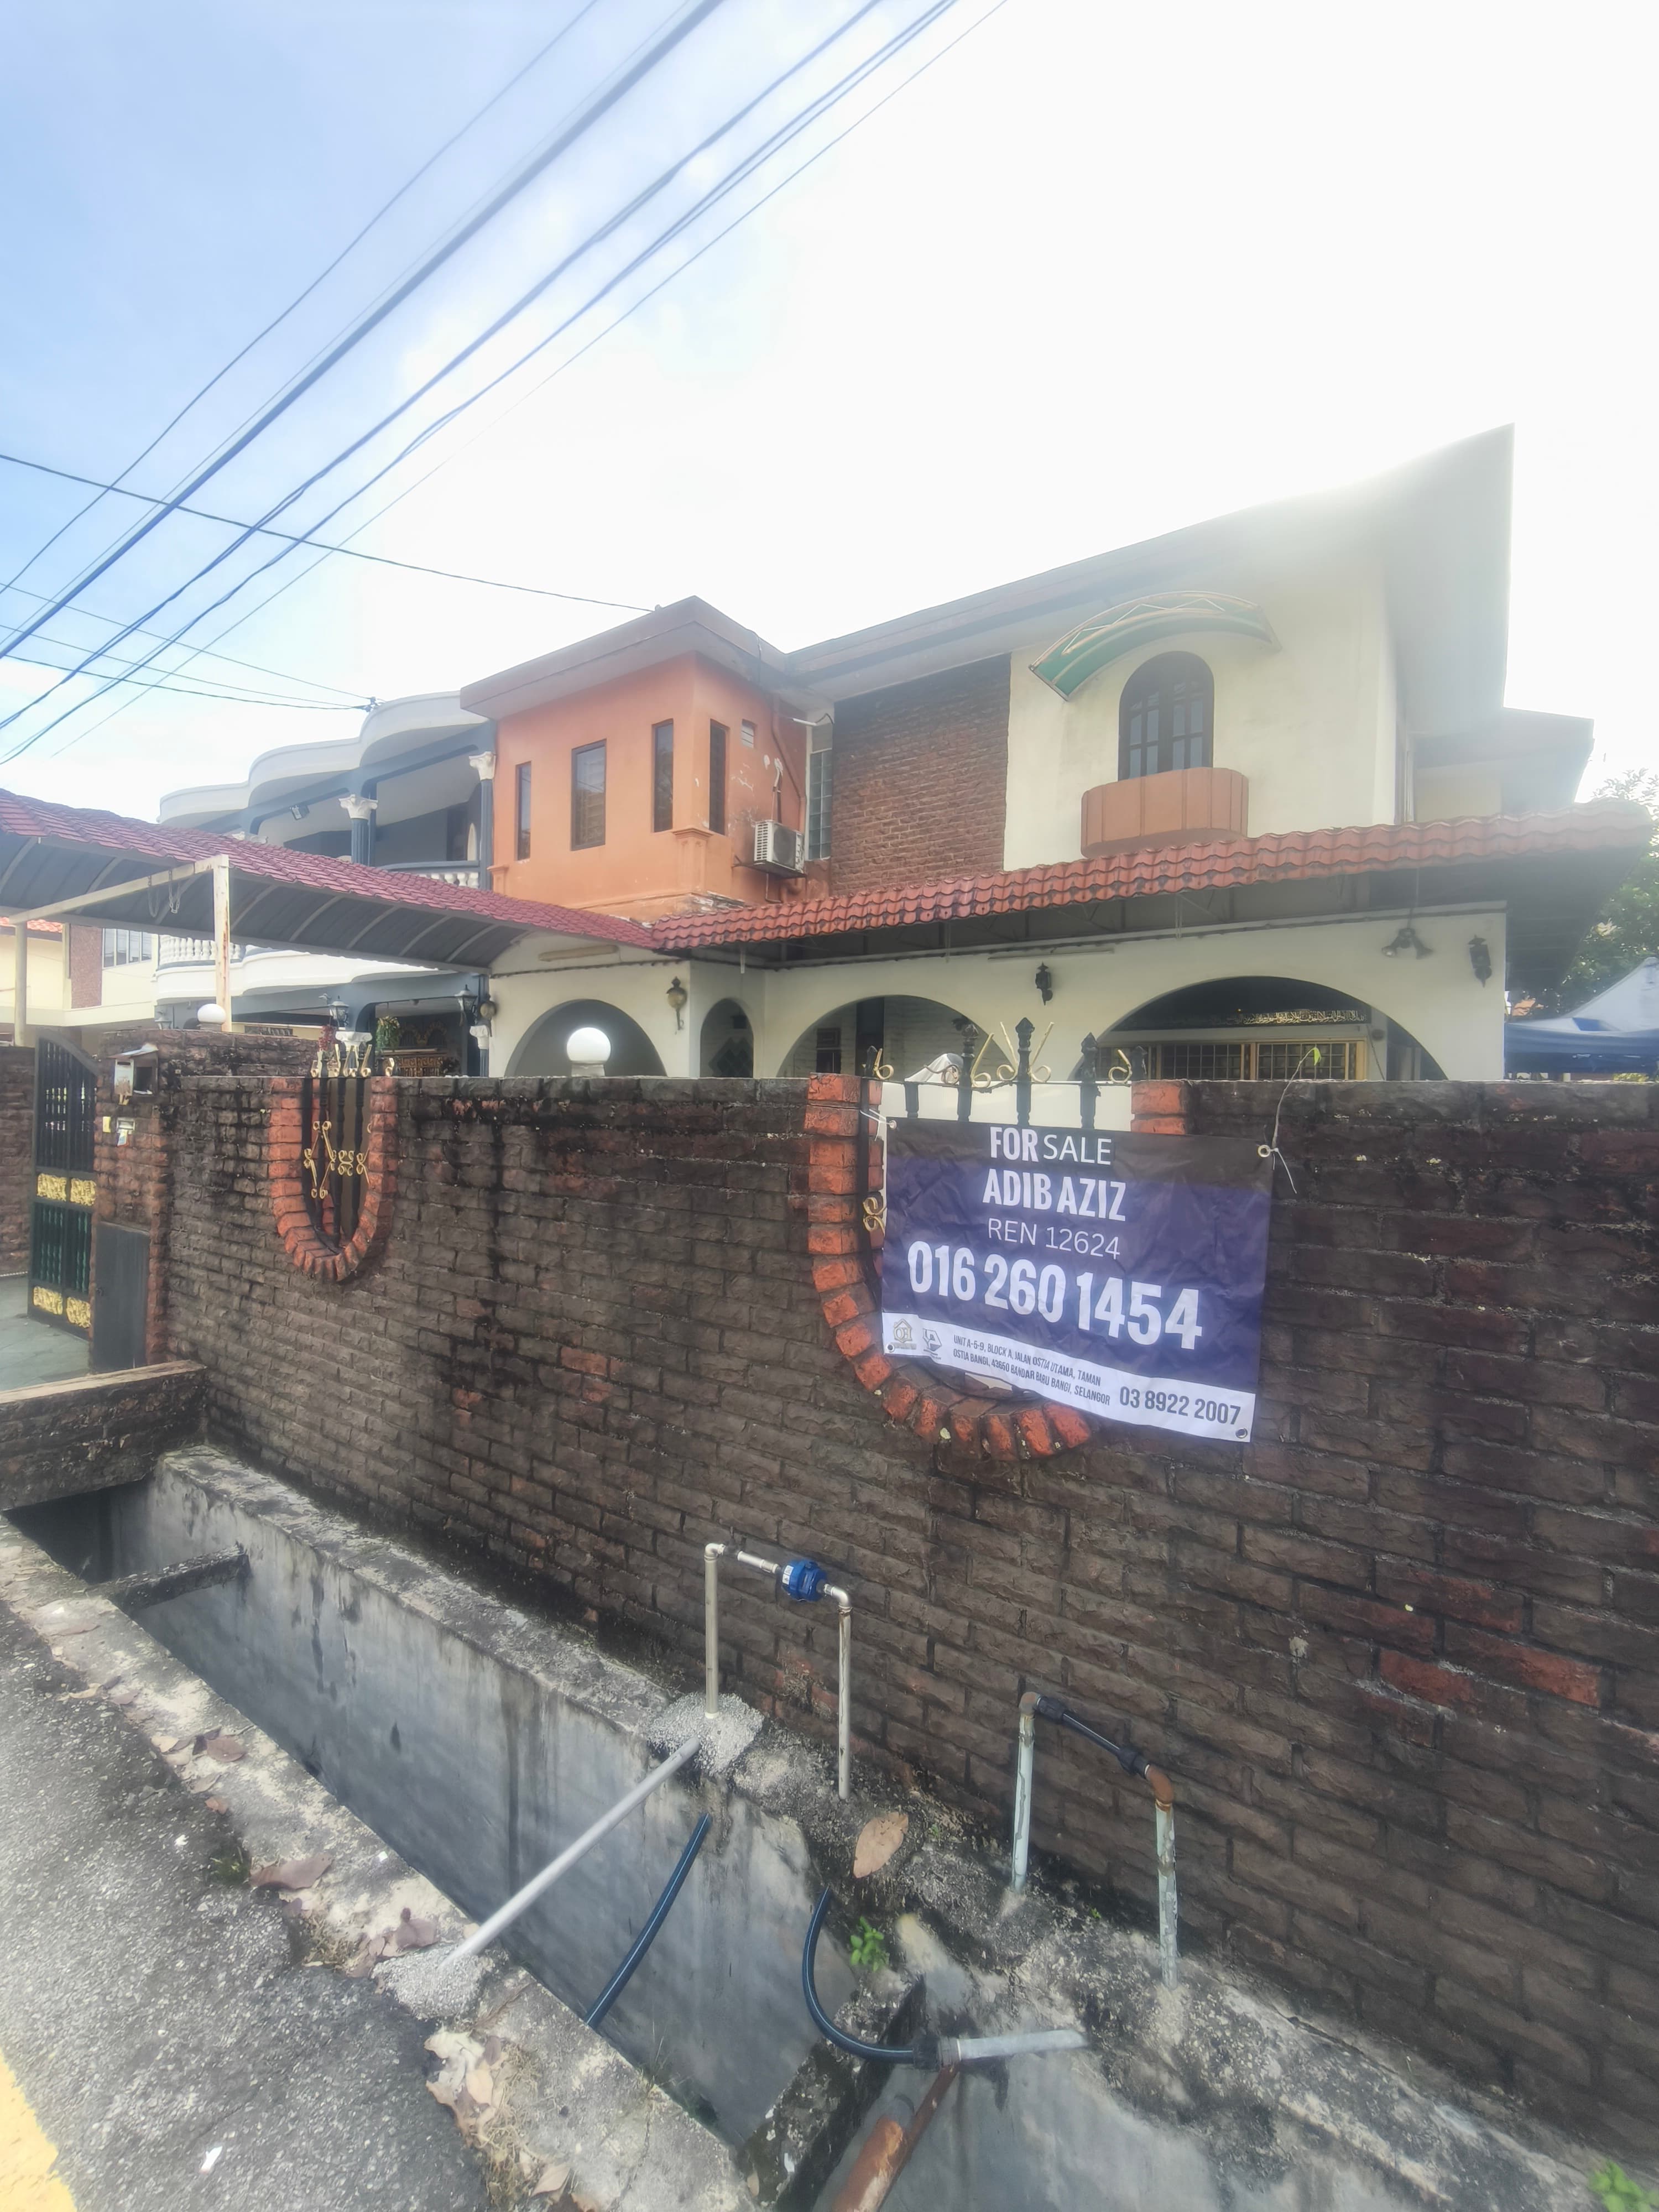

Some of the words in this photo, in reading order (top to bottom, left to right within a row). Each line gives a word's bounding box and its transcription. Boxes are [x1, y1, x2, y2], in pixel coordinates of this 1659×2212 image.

[990, 1126, 1039, 1162] FOR
[1044, 1134, 1112, 1165] SALE
[982, 1168, 1052, 1210] ADIB
[1057, 1176, 1126, 1222] AZIZ
[988, 1218, 1037, 1245] REN
[1046, 1227, 1121, 1260] 12624
[907, 1241, 976, 1301] 016
[984, 1254, 1066, 1323] 260
[1076, 1272, 1203, 1350] 1454
[953, 1348, 969, 1361] OSTIA
[992, 1359, 1010, 1372] 43650
[1011, 1364, 1035, 1380] BANDAR
[1036, 1371, 1050, 1386] BARU
[1074, 1385, 1110, 1405] SELANGOR
[954, 1335, 966, 1346] UNIT
[967, 1339, 986, 1352] A-5-9,
[988, 1343, 1007, 1357] BLOCK
[1015, 1352, 1031, 1365] JALAN
[1032, 1357, 1050, 1371] OSTIA
[1051, 1362, 1075, 1379] UTAMA,
[1078, 1370, 1101, 1386] TAMAN
[1120, 1386, 1140, 1408] 03
[1145, 1390, 1190, 1416] 8922
[1194, 1399, 1241, 1425] 2007
